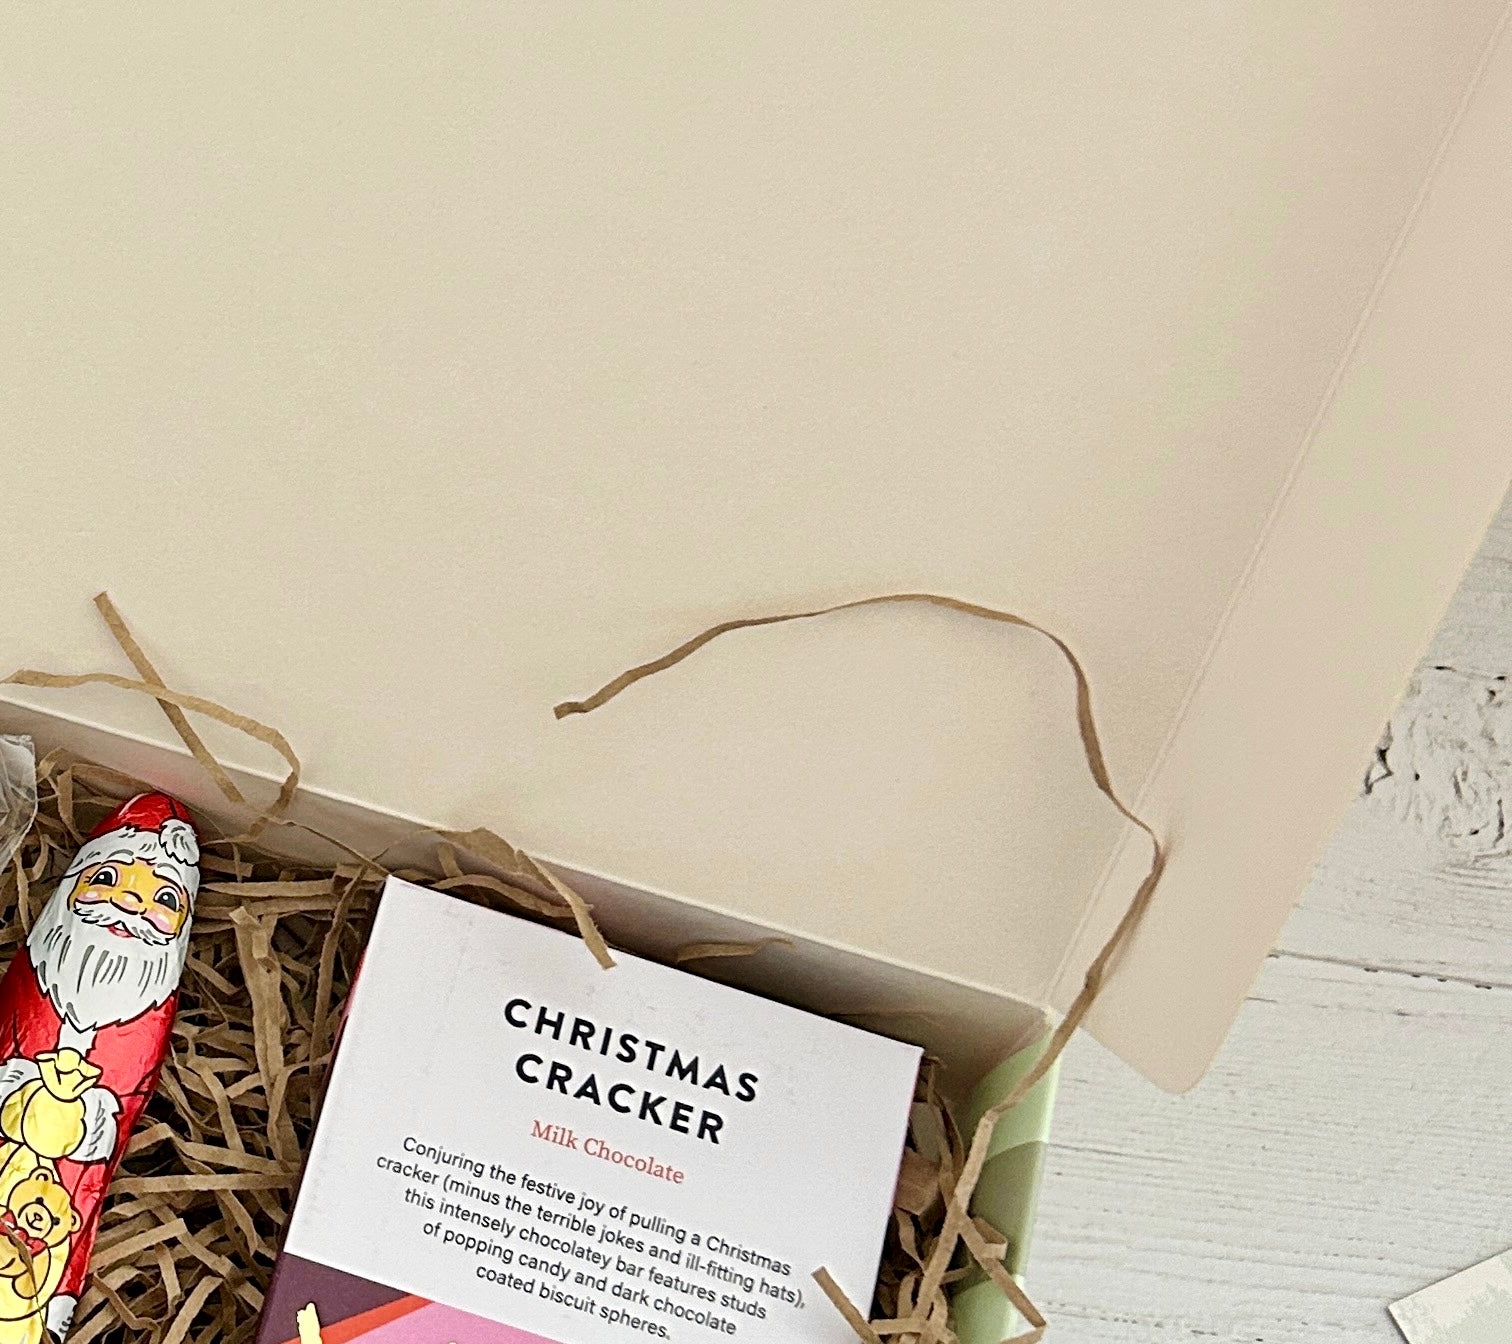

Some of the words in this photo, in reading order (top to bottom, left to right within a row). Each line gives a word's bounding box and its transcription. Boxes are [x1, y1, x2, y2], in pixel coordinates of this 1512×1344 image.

[504, 998, 759, 1102] CHRISTMAS
[515, 1053, 723, 1144] CRACKER
[403, 1136, 485, 1177] Conjuring
[489, 1164, 516, 1185] the
[521, 1174, 576, 1204] festive
[578, 1191, 605, 1216] joy
[609, 1206, 628, 1221] of
[629, 1213, 686, 1244] pulling
[691, 1233, 701, 1246] a
[706, 1236, 791, 1276] Christmas
[530, 1120, 579, 1150] Milk
[583, 1137, 685, 1184] Chocolate
[377, 1156, 439, 1185] cracker
[443, 1174, 500, 1206] (minus
[505, 1195, 532, 1215] the
[537, 1205, 596, 1237] terrible
[598, 1224, 645, 1253] jokes
[648, 1245, 682, 1265] and
[685, 1252, 755, 1293] ill-fitting
[404, 1188, 435, 1210] this
[439, 1198, 516, 1239] intensely
[519, 1227, 612, 1270] chocolatey
[616, 1256, 645, 1277] bar
[648, 1267, 716, 1303] features
[720, 1294, 767, 1319] studs
[423, 1222, 442, 1237] of
[443, 1229, 514, 1264] popping
[518, 1253, 571, 1282] candy
[574, 1271, 607, 1292] and
[611, 1282, 650, 1306] dark
[654, 1297, 737, 1335] chocolate
[476, 1265, 535, 1294] coated
[539, 1282, 597, 1315] biscuit
[599, 1305, 671, 1341] spheres.
